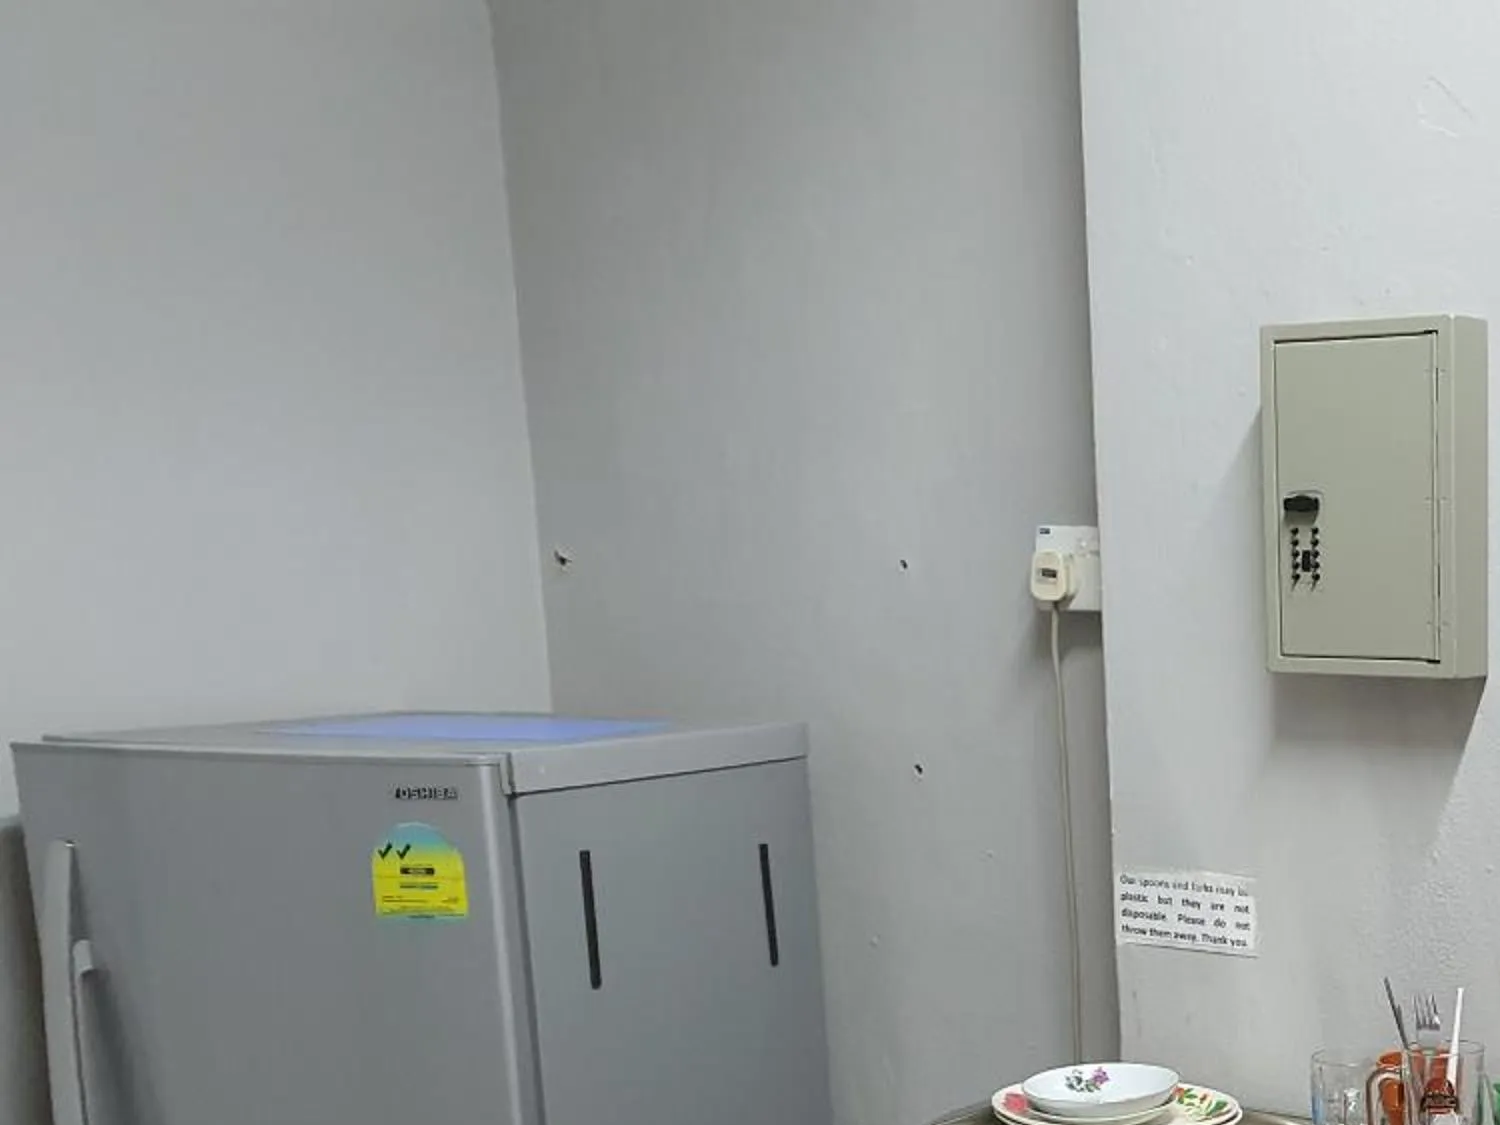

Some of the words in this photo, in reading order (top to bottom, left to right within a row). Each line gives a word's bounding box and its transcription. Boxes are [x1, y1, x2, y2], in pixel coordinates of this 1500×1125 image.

[1140, 878, 1170, 889] spoons
[1157, 895, 1173, 906] but
[1181, 897, 1201, 910] they
[1211, 902, 1225, 911] are
[1234, 904, 1250, 914] not
[1177, 913, 1205, 926] Please
[1213, 917, 1227, 928] do
[1235, 921, 1251, 931] not
[1121, 924, 1147, 936] throw
[1150, 928, 1172, 938] them
[1201, 932, 1227, 945] Thank
